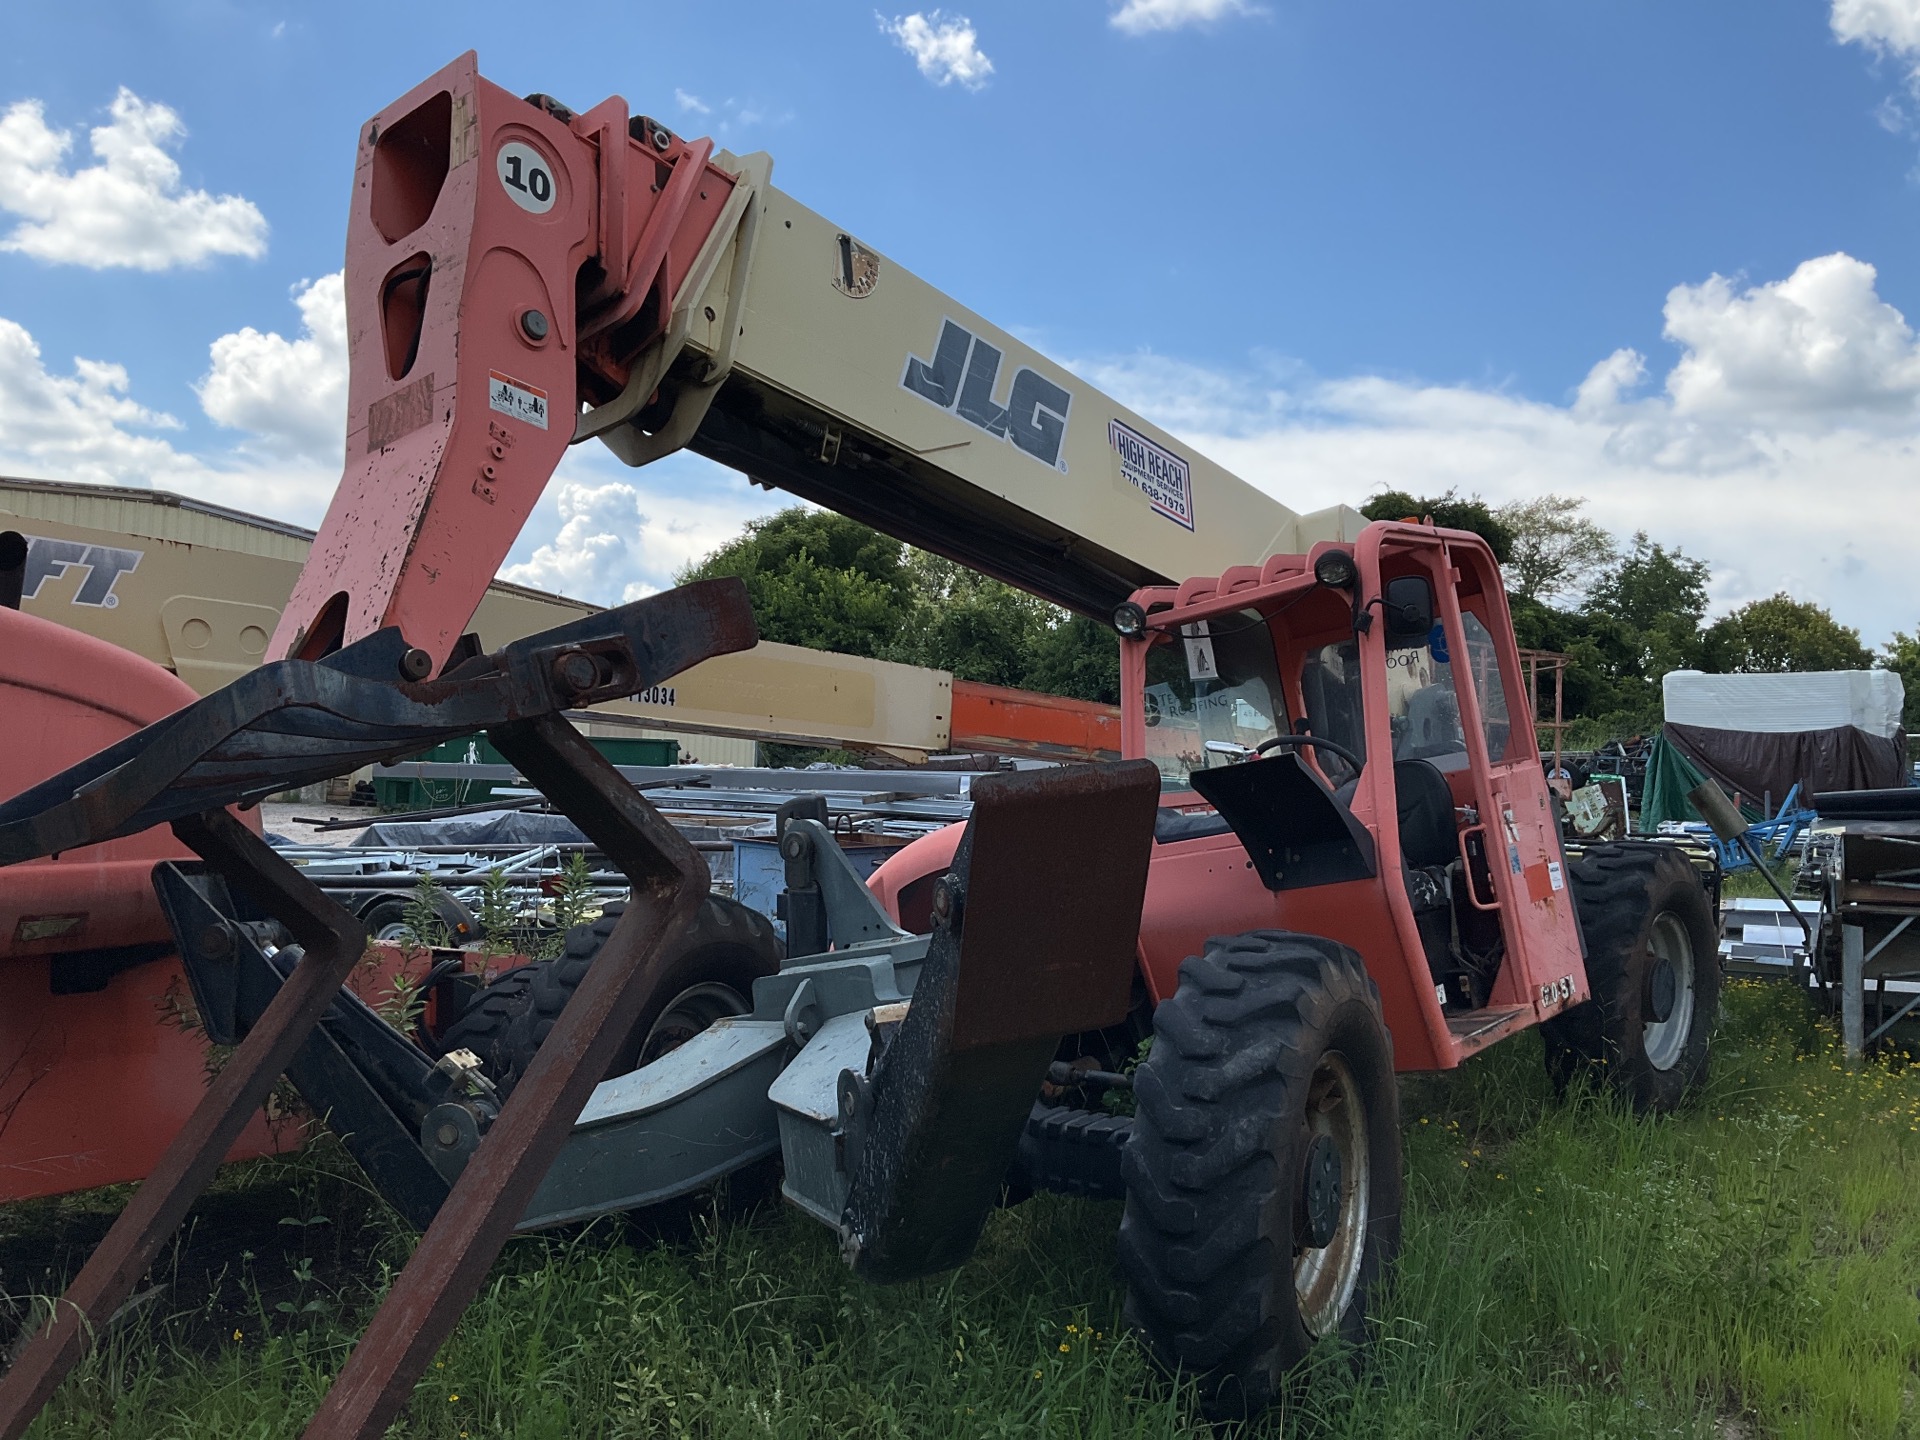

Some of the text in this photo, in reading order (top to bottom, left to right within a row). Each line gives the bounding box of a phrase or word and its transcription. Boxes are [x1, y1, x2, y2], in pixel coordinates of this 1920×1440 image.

[504, 155, 551, 202] 10
[902, 317, 1071, 469] JLG
[1117, 432, 1183, 492] HIGH REACH
[1122, 459, 1184, 501] QUIPMENT SERVICES
[1141, 482, 1186, 515] 638-7979
[21, 537, 144, 606] FT
